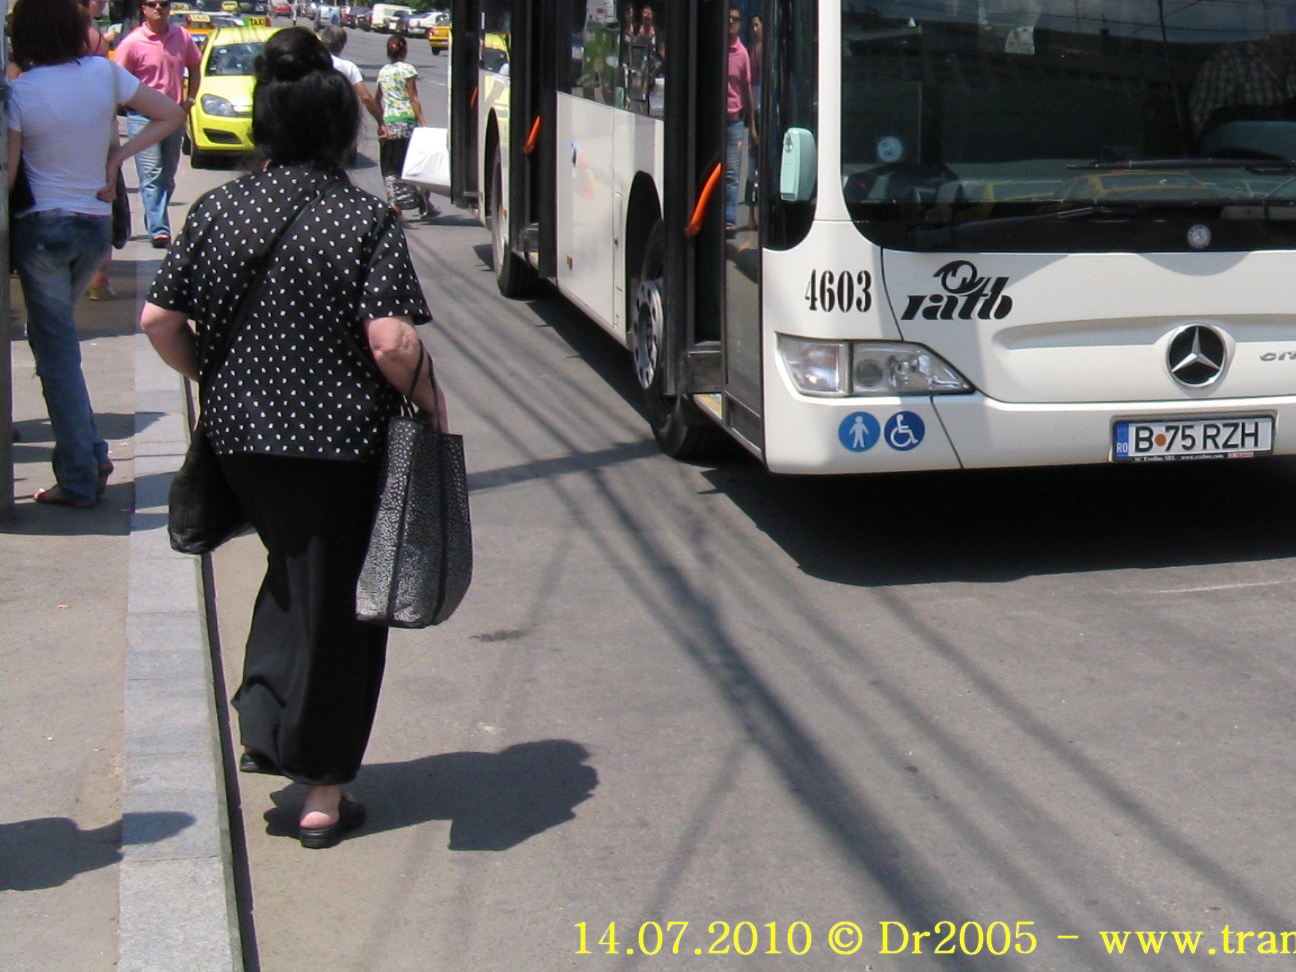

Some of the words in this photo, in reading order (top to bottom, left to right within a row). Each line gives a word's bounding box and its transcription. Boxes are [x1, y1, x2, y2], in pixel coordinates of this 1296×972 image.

[249, 18, 266, 26] TAXI
[805, 269, 872, 313] 4603
[901, 271, 1013, 321] ratb
[1116, 442, 1129, 454] RO
[1134, 425, 1154, 453] B
[1202, 421, 1260, 450] RZH
